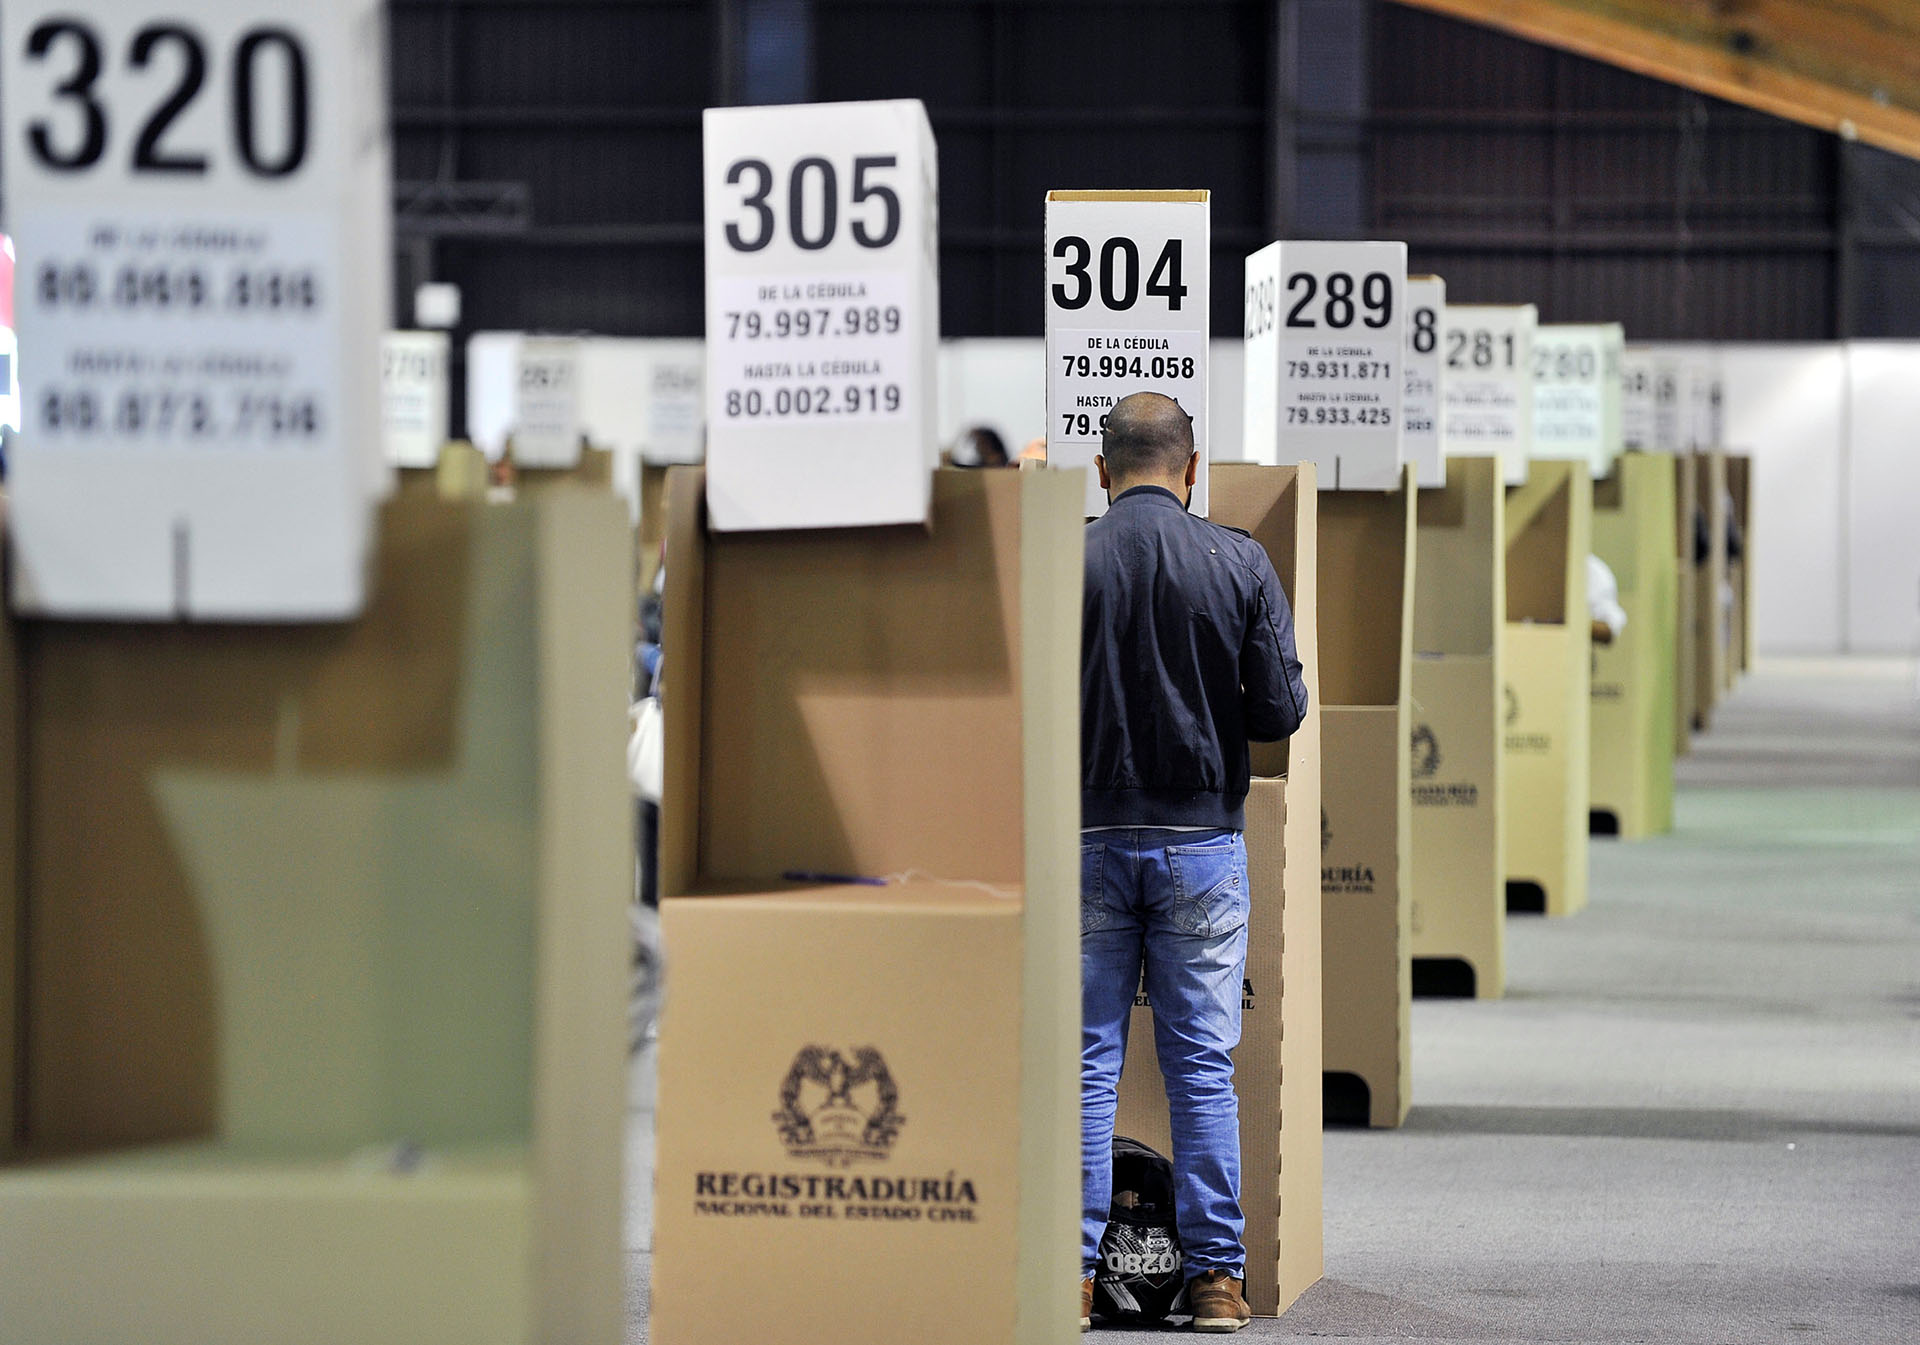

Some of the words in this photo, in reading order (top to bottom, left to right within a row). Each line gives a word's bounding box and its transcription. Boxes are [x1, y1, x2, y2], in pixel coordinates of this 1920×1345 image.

[23, 16, 314, 181] 320
[723, 155, 902, 253] 305
[1051, 236, 1188, 311] 304
[758, 285, 778, 301] DE
[782, 284, 801, 300] LA
[1285, 271, 1394, 329] 289
[725, 305, 901, 340] 79.997.989
[1087, 337, 1103, 349] DE
[1106, 338, 1121, 350] LA
[1123, 335, 1170, 351] CÉDULA
[1446, 328, 1514, 369] 281
[743, 363, 792, 378] HASTA
[799, 362, 816, 377] LA
[1062, 355, 1195, 379] 79.994.058
[1285, 359, 1391, 379] 79.931.871
[725, 384, 901, 418] 80.002.919
[1076, 395, 1113, 407] HASTA
[1285, 406, 1392, 425] 79.933.425
[1132, 994, 1151, 1007] EL
[695, 1169, 978, 1204] REGISTRADURÍA
[694, 1201, 790, 1218] NACIONAL
[799, 1204, 838, 1219] DEL
[844, 1205, 922, 1222] ESTADO
[926, 1207, 979, 1223] CIVIL
